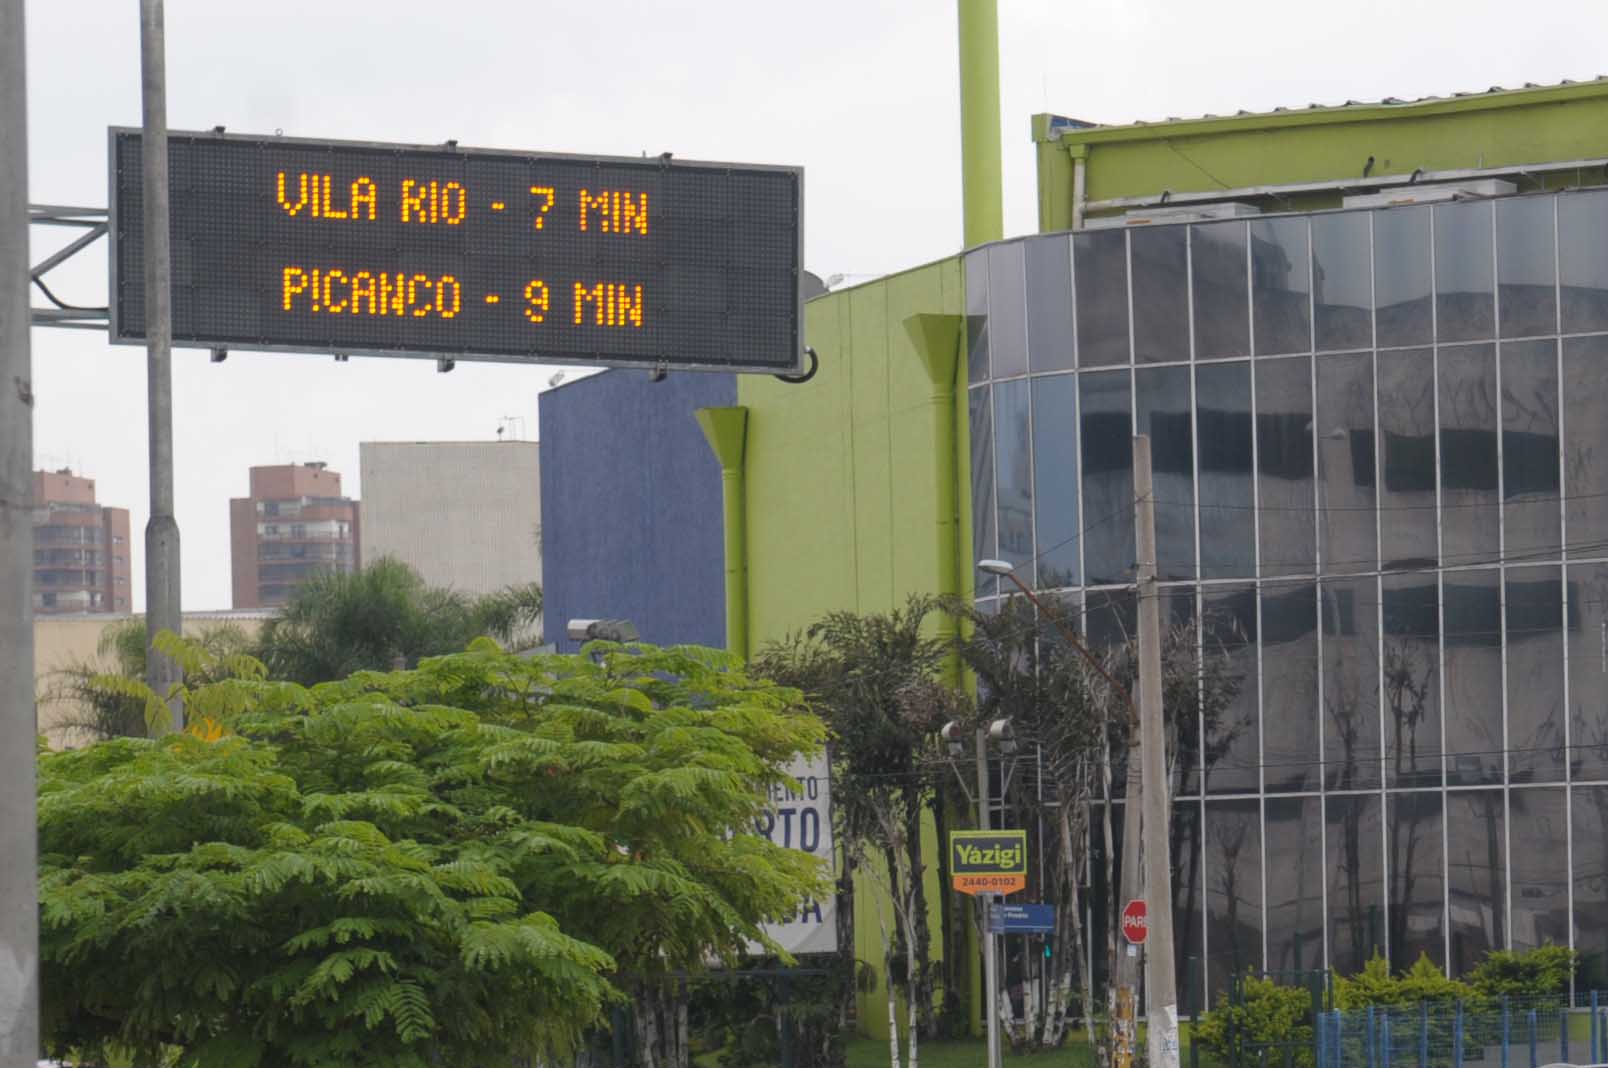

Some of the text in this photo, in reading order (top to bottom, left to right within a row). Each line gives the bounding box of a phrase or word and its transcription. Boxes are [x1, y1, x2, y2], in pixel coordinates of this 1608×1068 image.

[277, 171, 648, 235] VILA RIO - 7 MIN
[283, 267, 643, 327] PICANCO - 9 MIN
